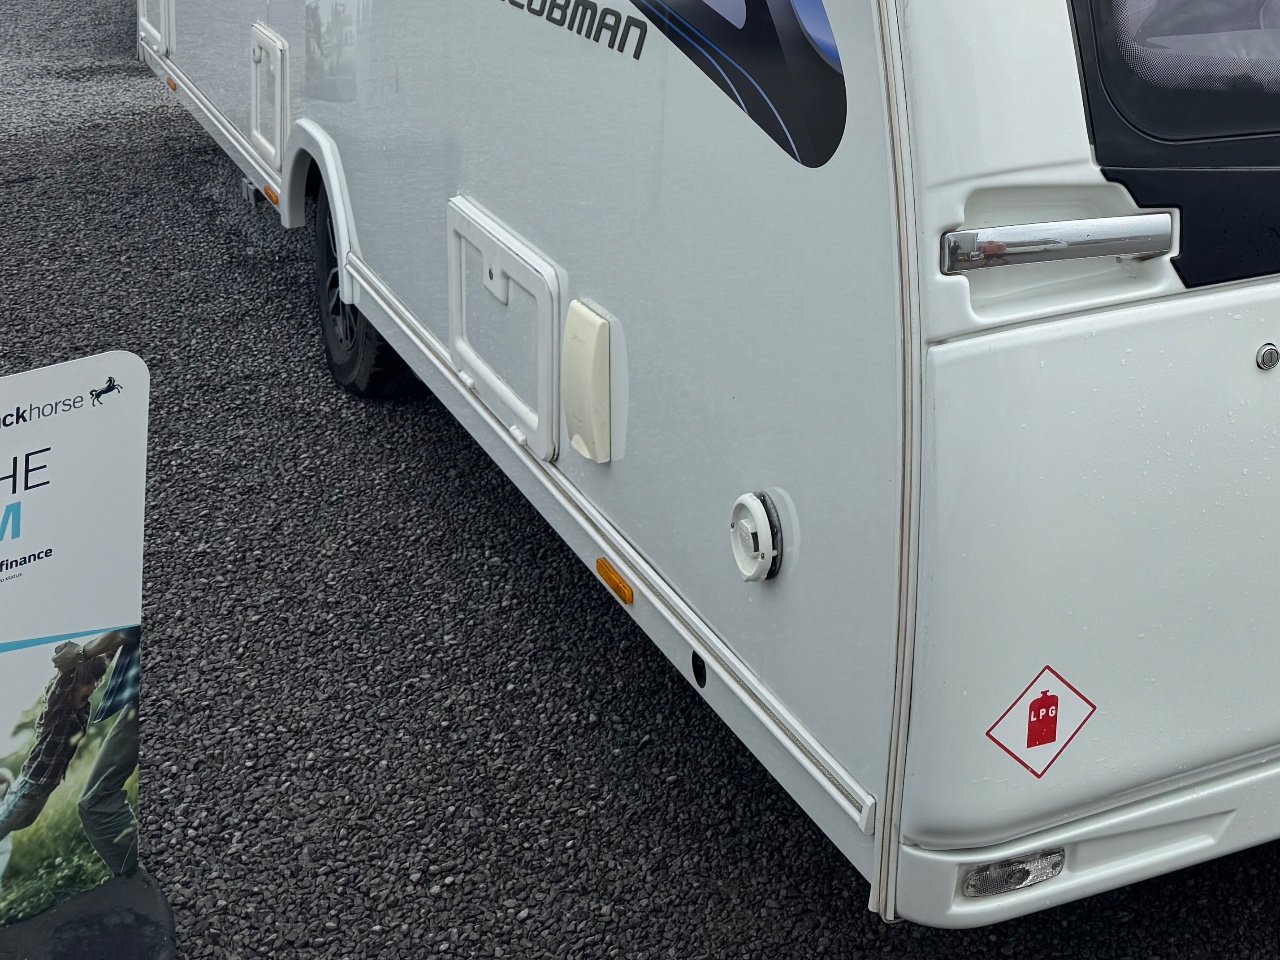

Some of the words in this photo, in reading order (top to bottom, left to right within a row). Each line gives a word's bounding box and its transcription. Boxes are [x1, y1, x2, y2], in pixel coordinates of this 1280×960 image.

[0, 395, 84, 429] ckhorse
[0, 548, 53, 573] finance
[1030, 705, 1056, 722] LPG
